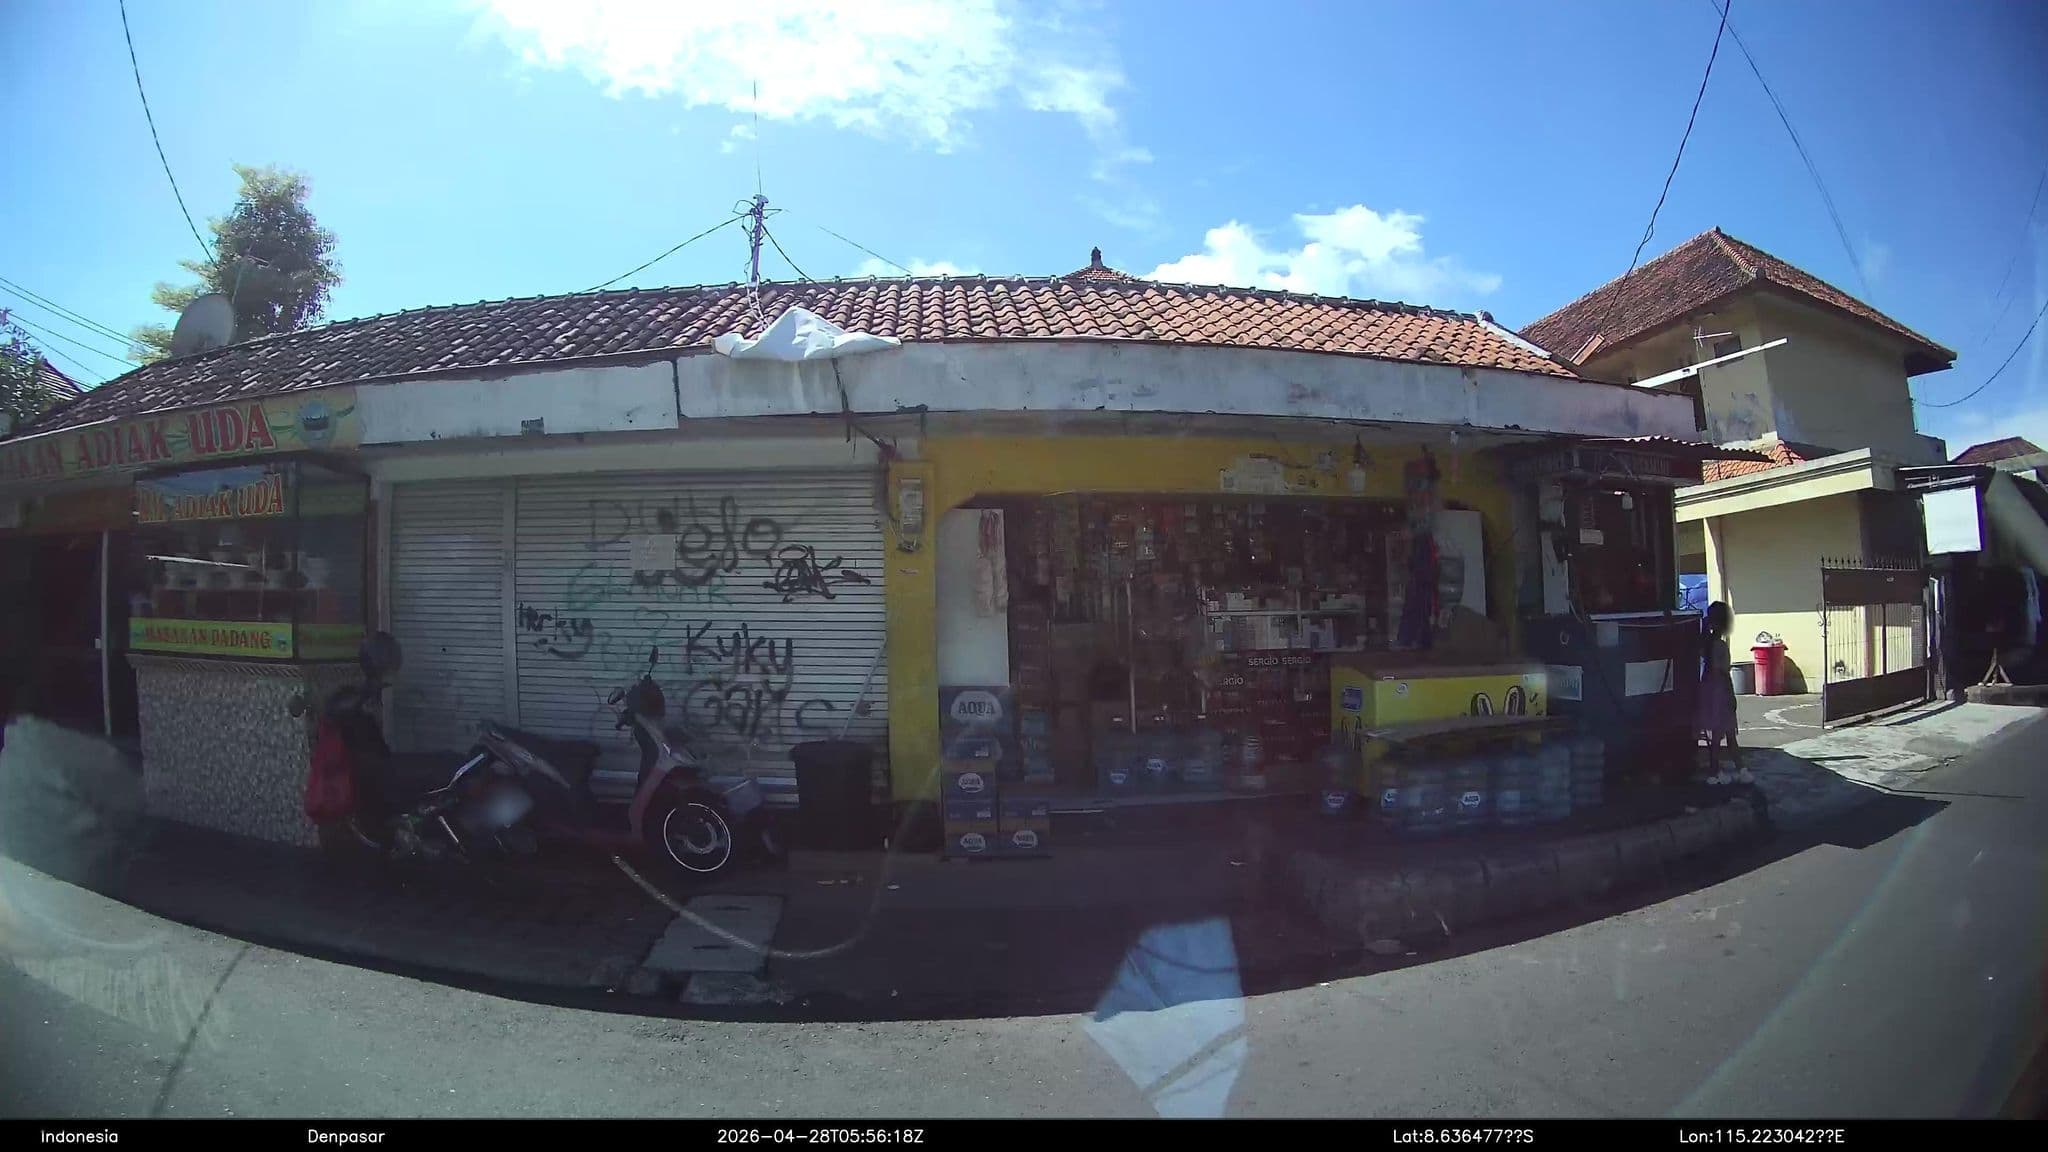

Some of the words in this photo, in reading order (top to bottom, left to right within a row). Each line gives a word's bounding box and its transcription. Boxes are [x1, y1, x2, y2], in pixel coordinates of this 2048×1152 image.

[186, 402, 276, 456] UDA
[237, 473, 285, 517] UDA
[211, 630, 273, 649] PADANG
[1247, 655, 1279, 667] SERGIO
[958, 702, 995, 717] AQUA
